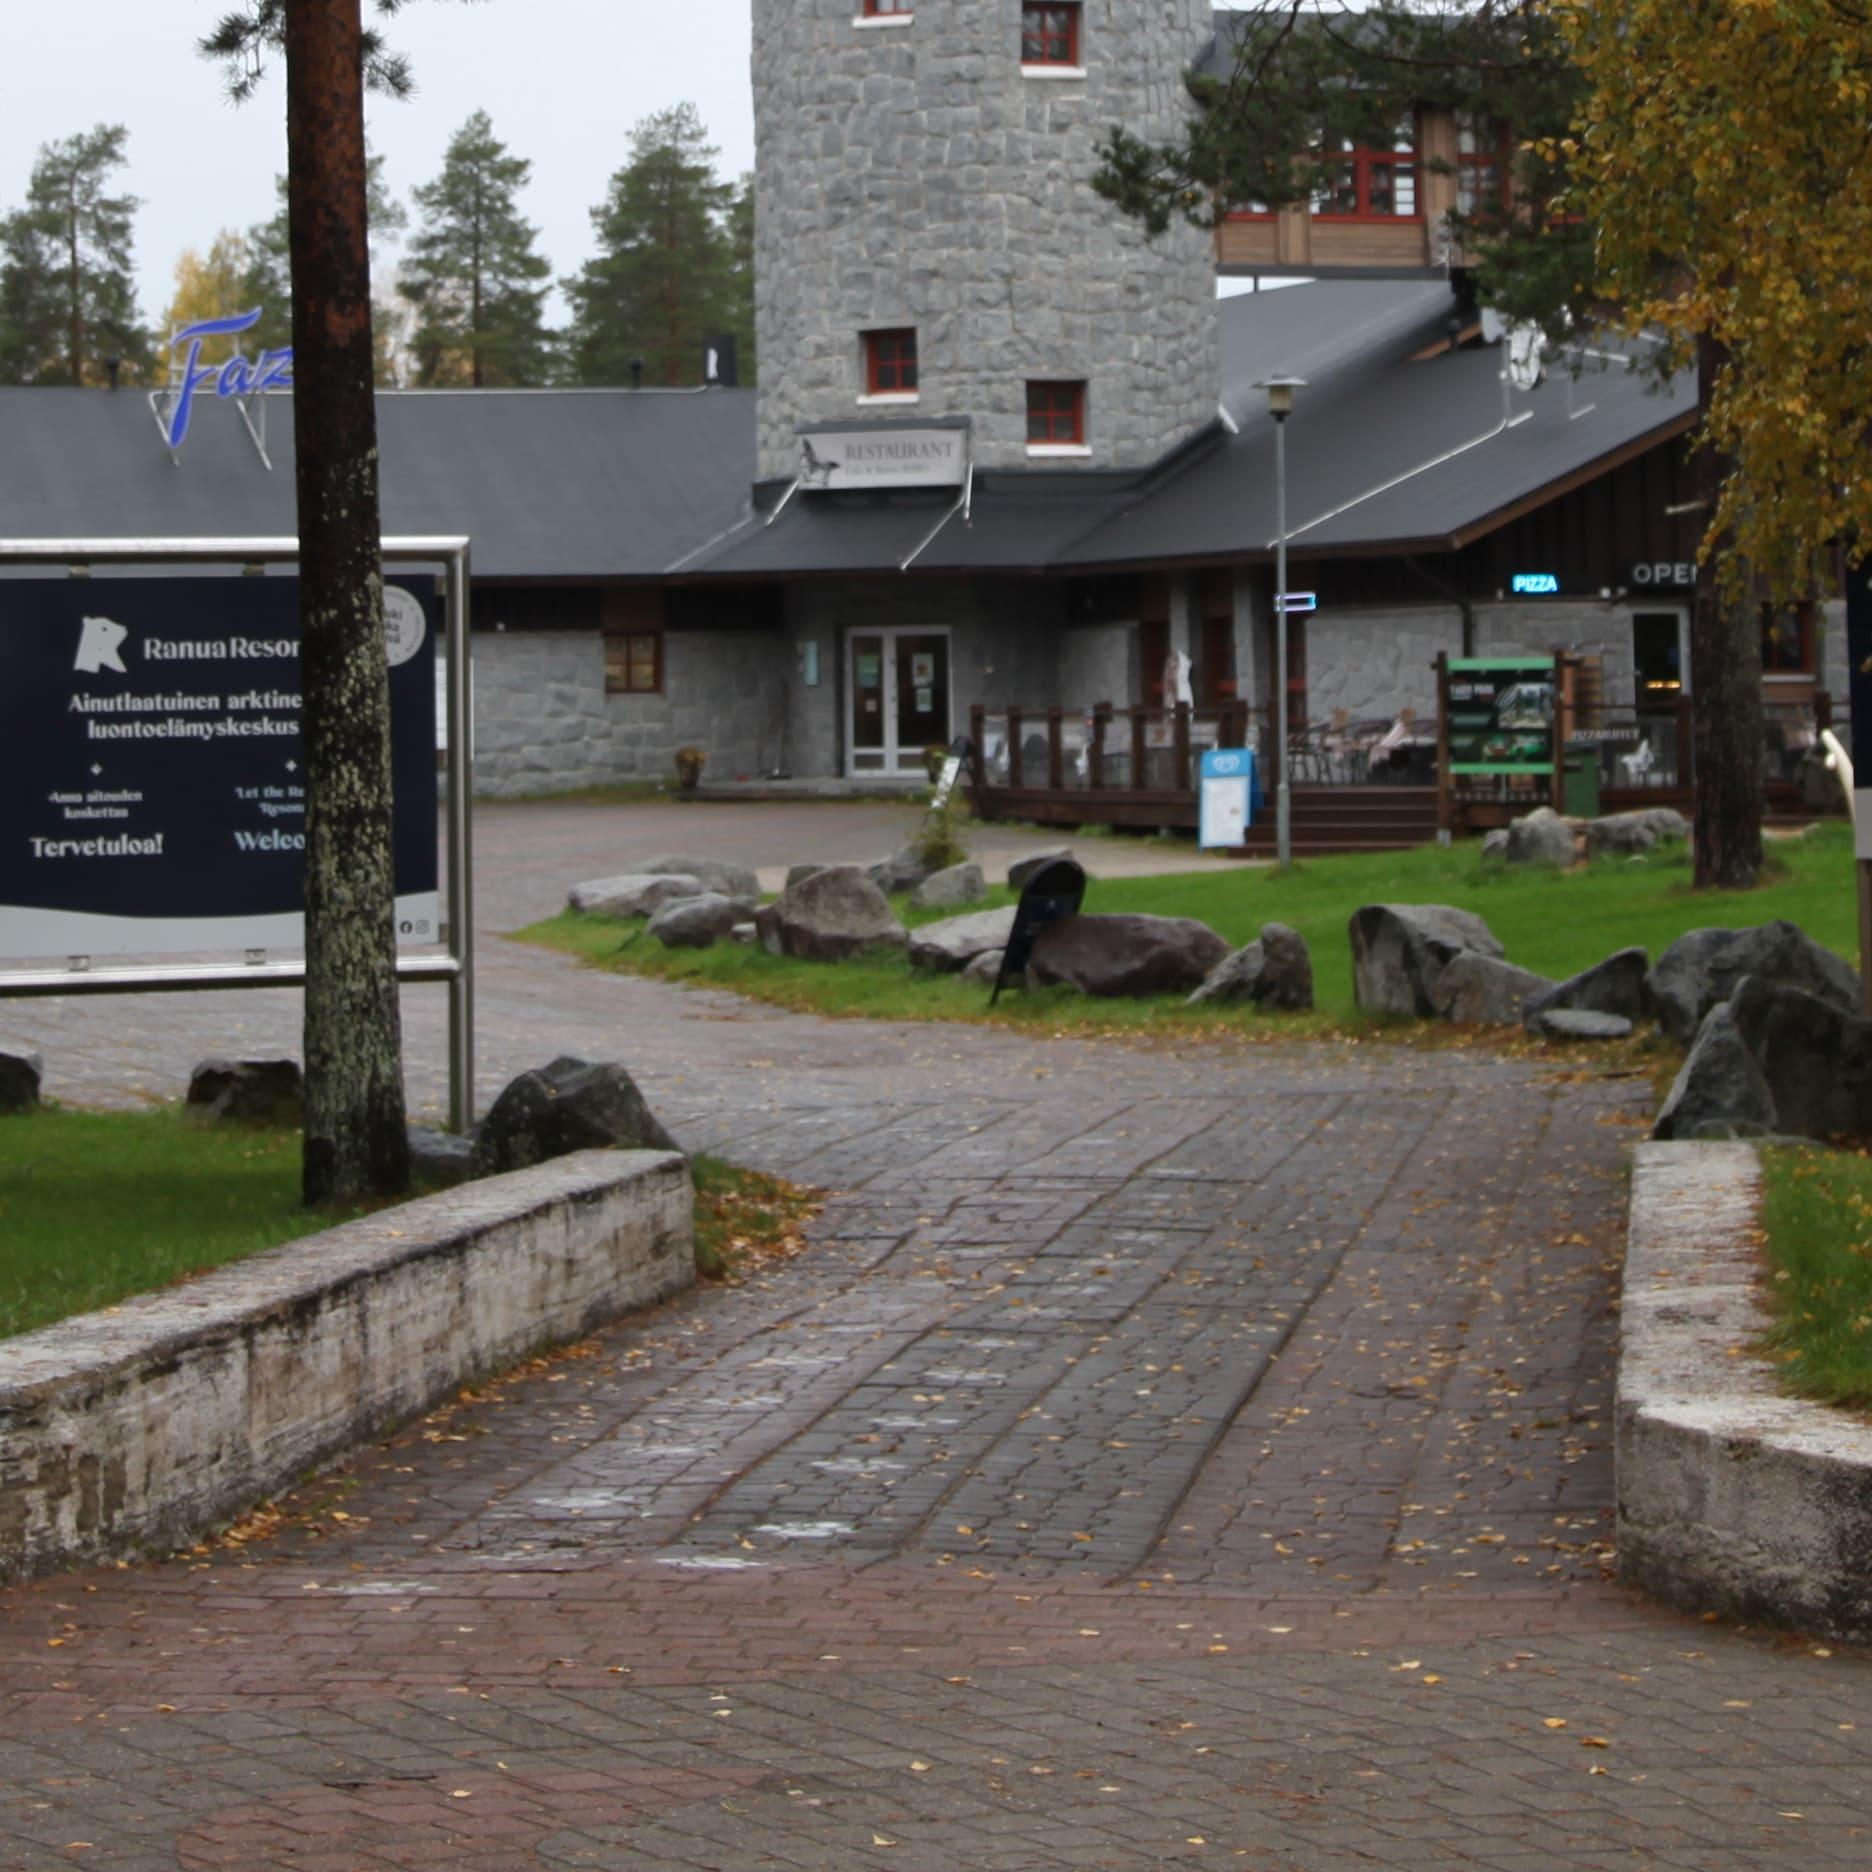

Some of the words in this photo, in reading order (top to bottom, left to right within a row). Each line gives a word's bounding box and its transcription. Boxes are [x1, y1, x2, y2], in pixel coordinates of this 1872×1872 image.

[169, 306, 294, 448] Faz
[846, 442, 954, 459] RESTAURANT
[1513, 574, 1558, 592] PIZZA
[1633, 563, 1697, 584] OPE
[144, 637, 227, 660] Ranua
[229, 636, 301, 658] Resor
[68, 691, 220, 714] Ainutlaatuinen
[227, 689, 303, 710] arktine
[88, 716, 300, 741] luontoelämyskeskus
[29, 832, 164, 858] Tervetuloa!
[233, 828, 305, 851] Welco
